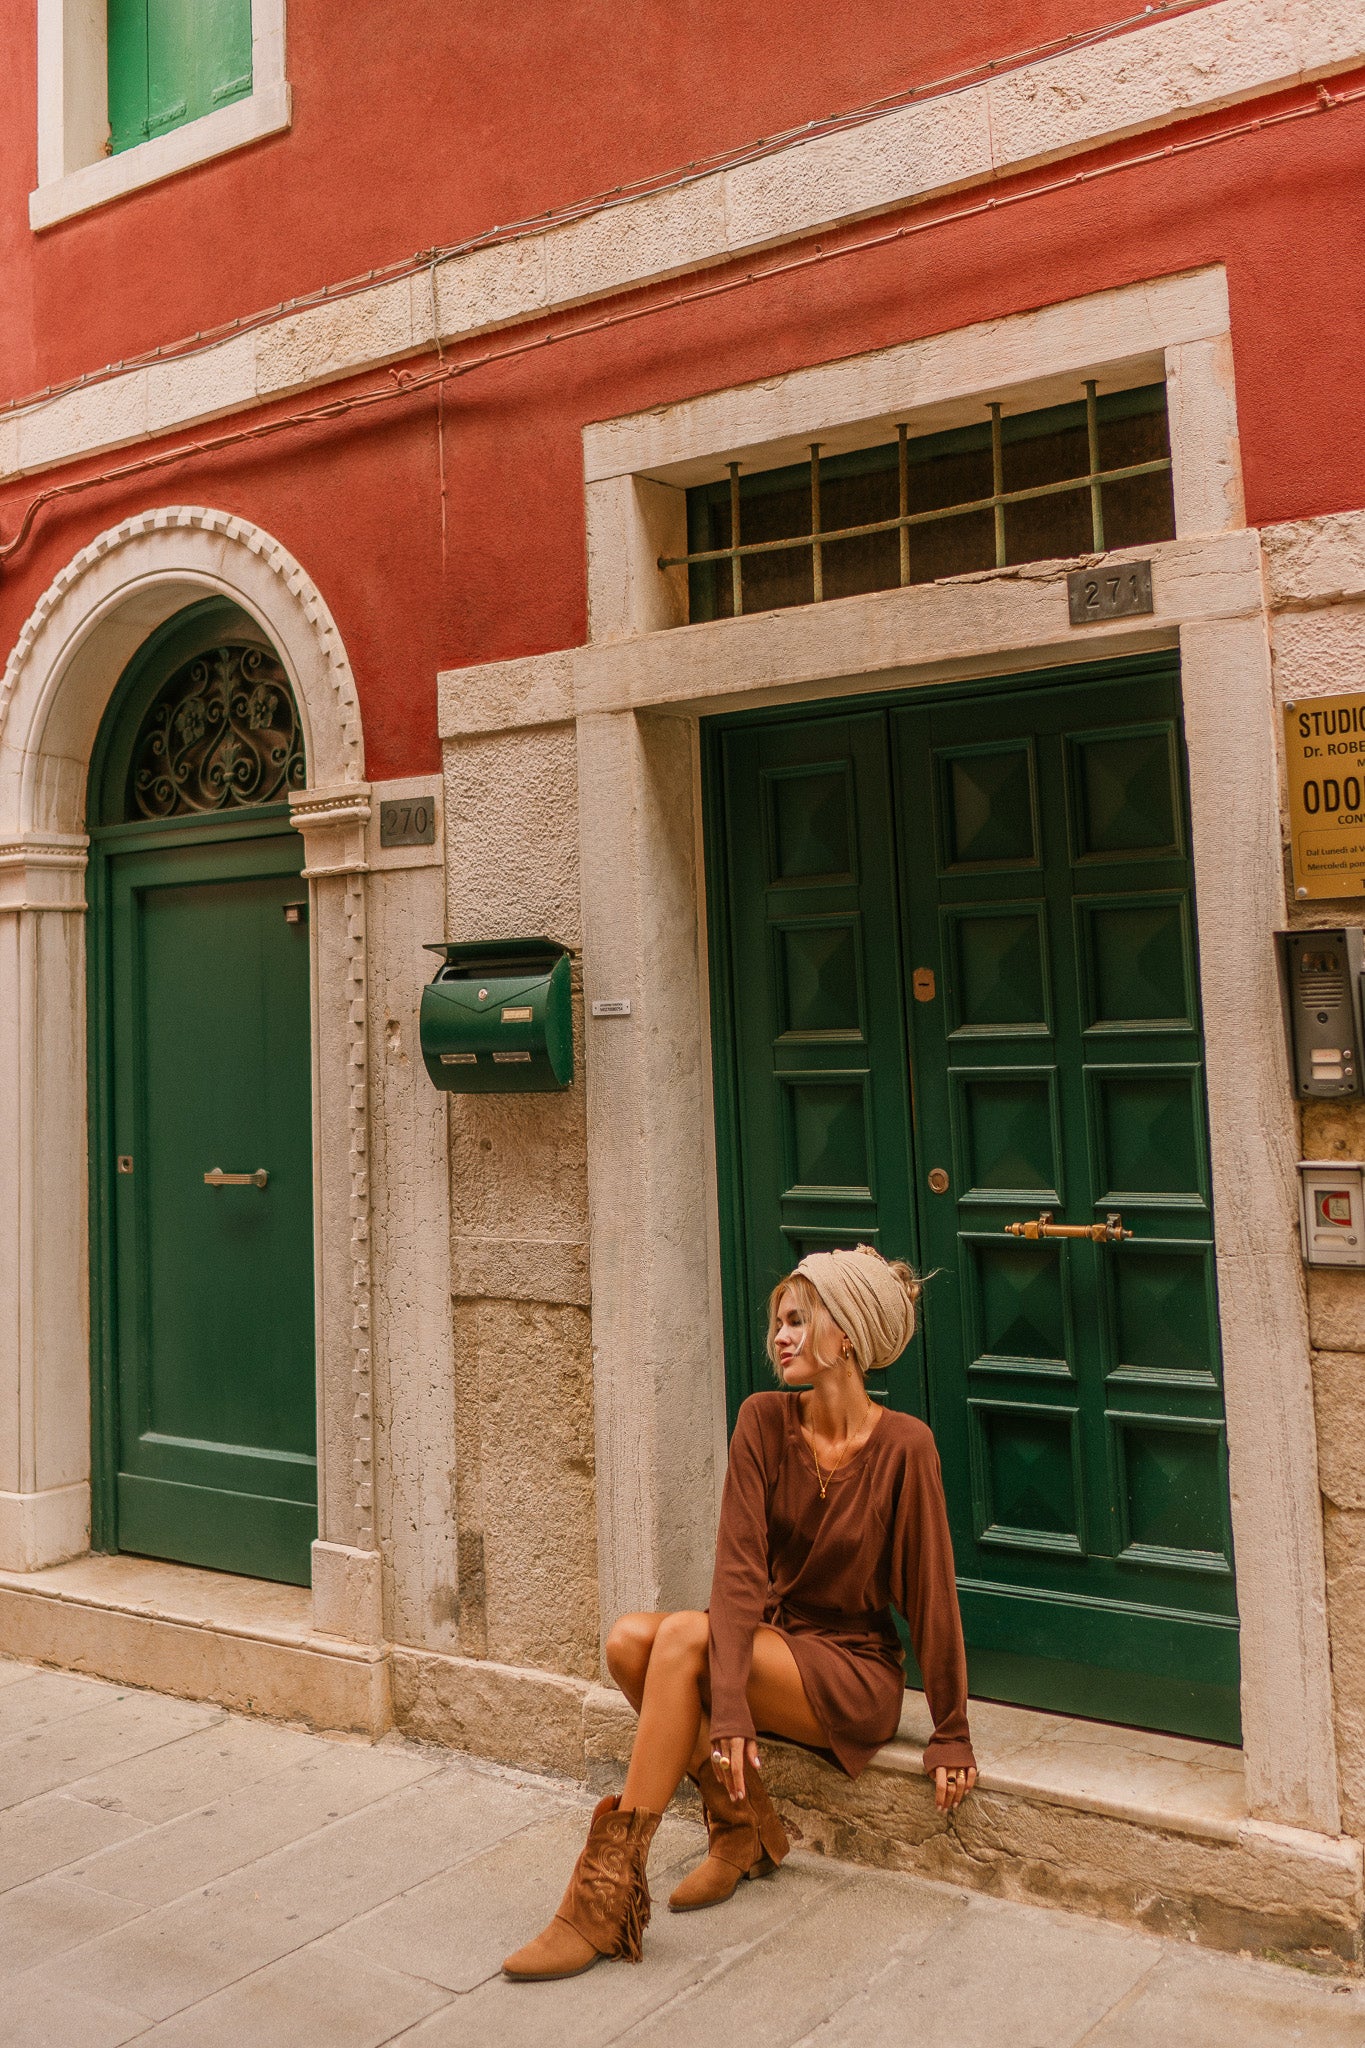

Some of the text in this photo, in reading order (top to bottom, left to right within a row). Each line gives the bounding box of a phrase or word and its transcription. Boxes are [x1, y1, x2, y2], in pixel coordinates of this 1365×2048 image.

[1085, 575, 1139, 609] 271
[1304, 746, 1323, 758] Dr.
[1303, 776, 1365, 815] ODO
[386, 806, 427, 836] 270
